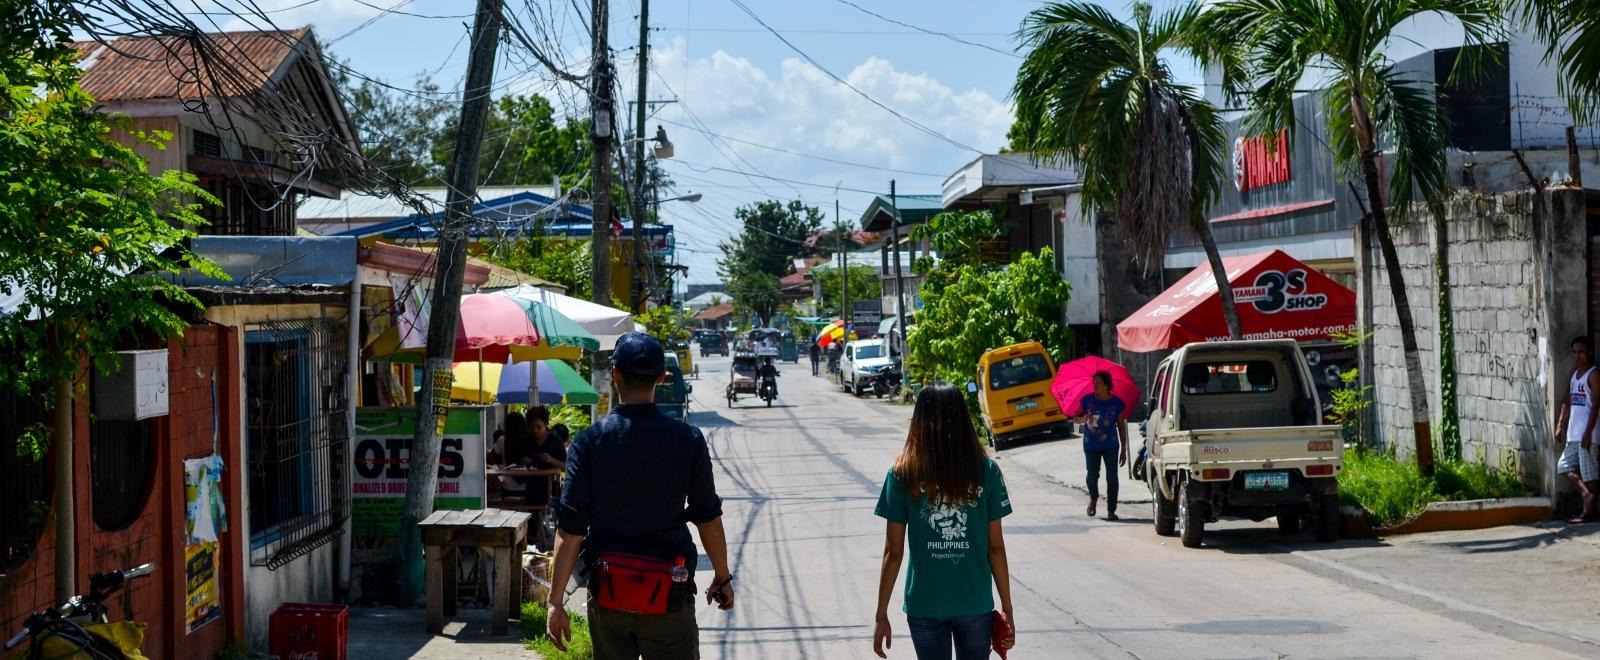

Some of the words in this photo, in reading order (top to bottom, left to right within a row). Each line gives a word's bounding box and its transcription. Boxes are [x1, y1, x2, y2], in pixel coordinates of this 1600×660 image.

[1245, 128, 1288, 189] YAMAHA
[1234, 288, 1266, 298] YAMAHA
[1286, 296, 1326, 309] SHOP
[438, 482, 460, 493] SMILE
[927, 541, 970, 550] PHILIPPINES
